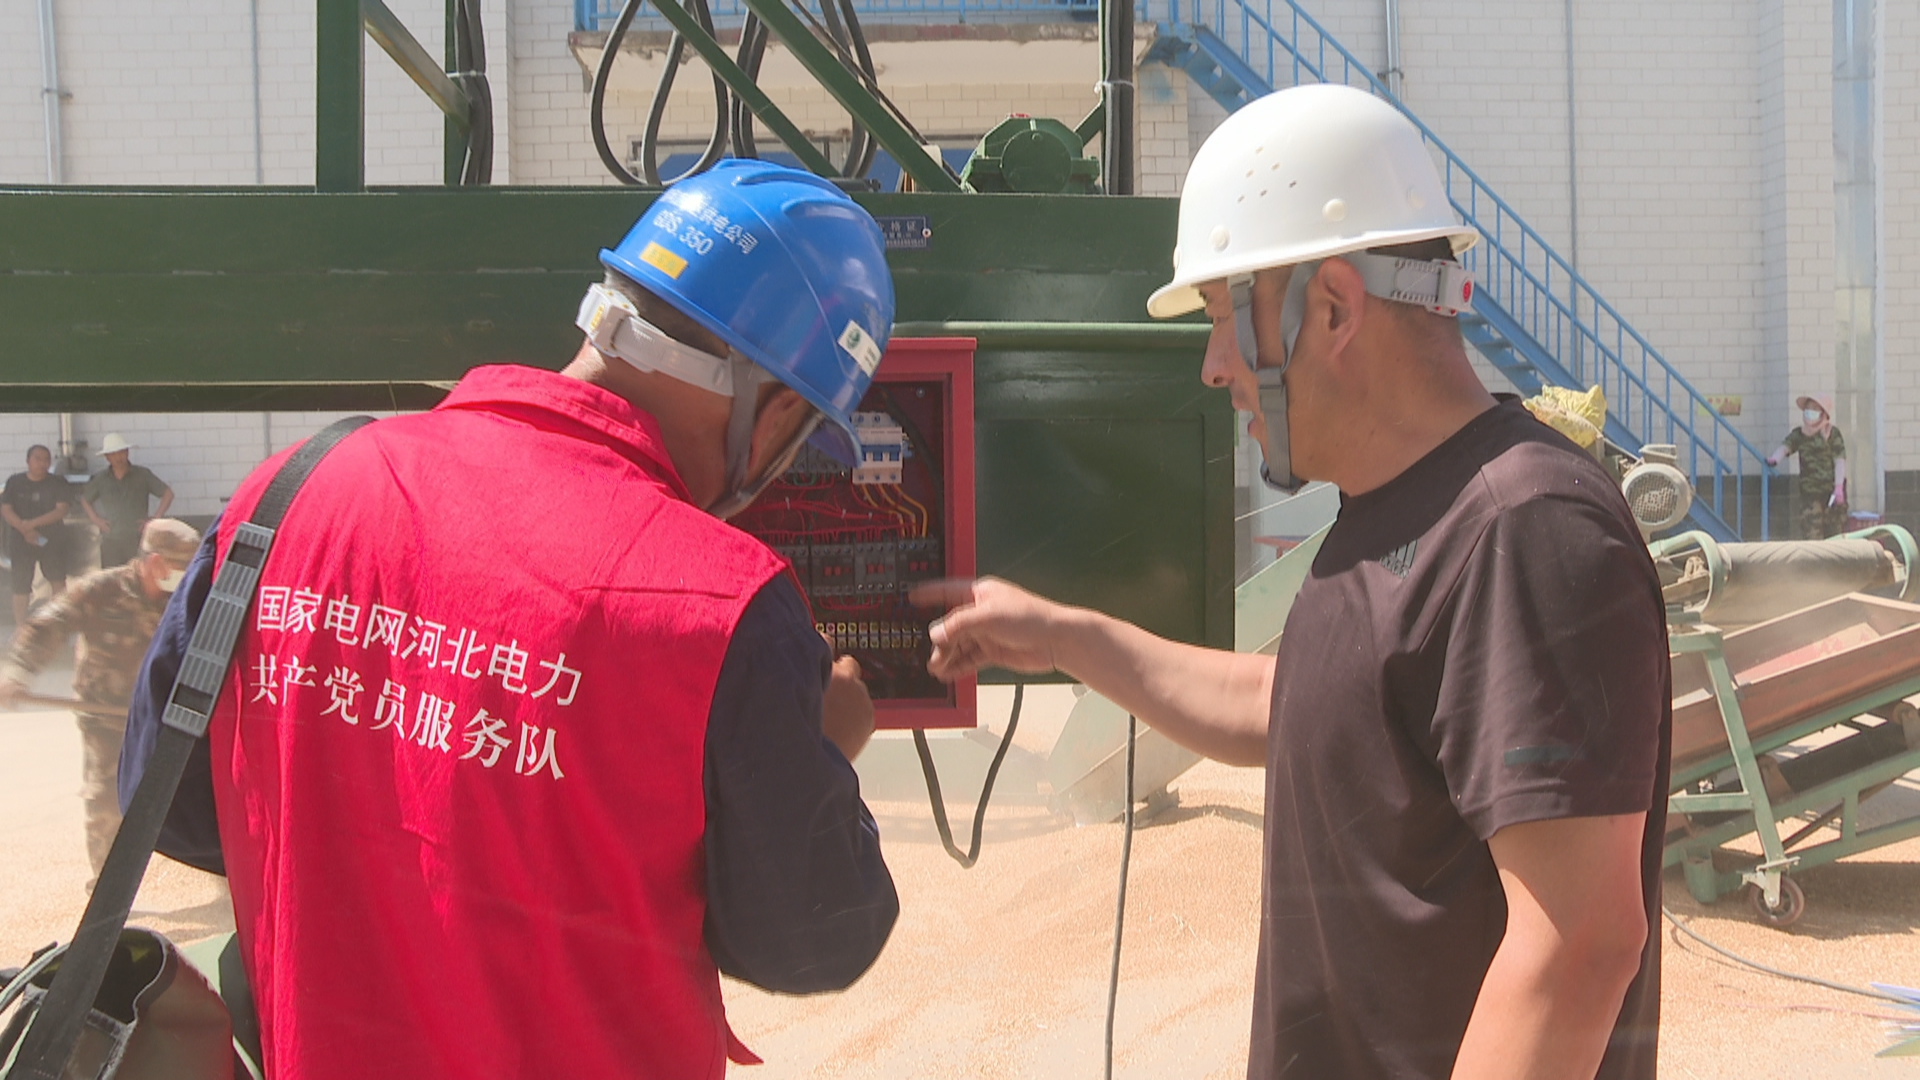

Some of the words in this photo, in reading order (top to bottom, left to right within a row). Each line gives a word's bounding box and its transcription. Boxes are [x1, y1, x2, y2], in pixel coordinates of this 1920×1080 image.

[256, 586, 582, 706] 国家电网河北电力
[250, 653, 565, 780] 共产党员服务队
